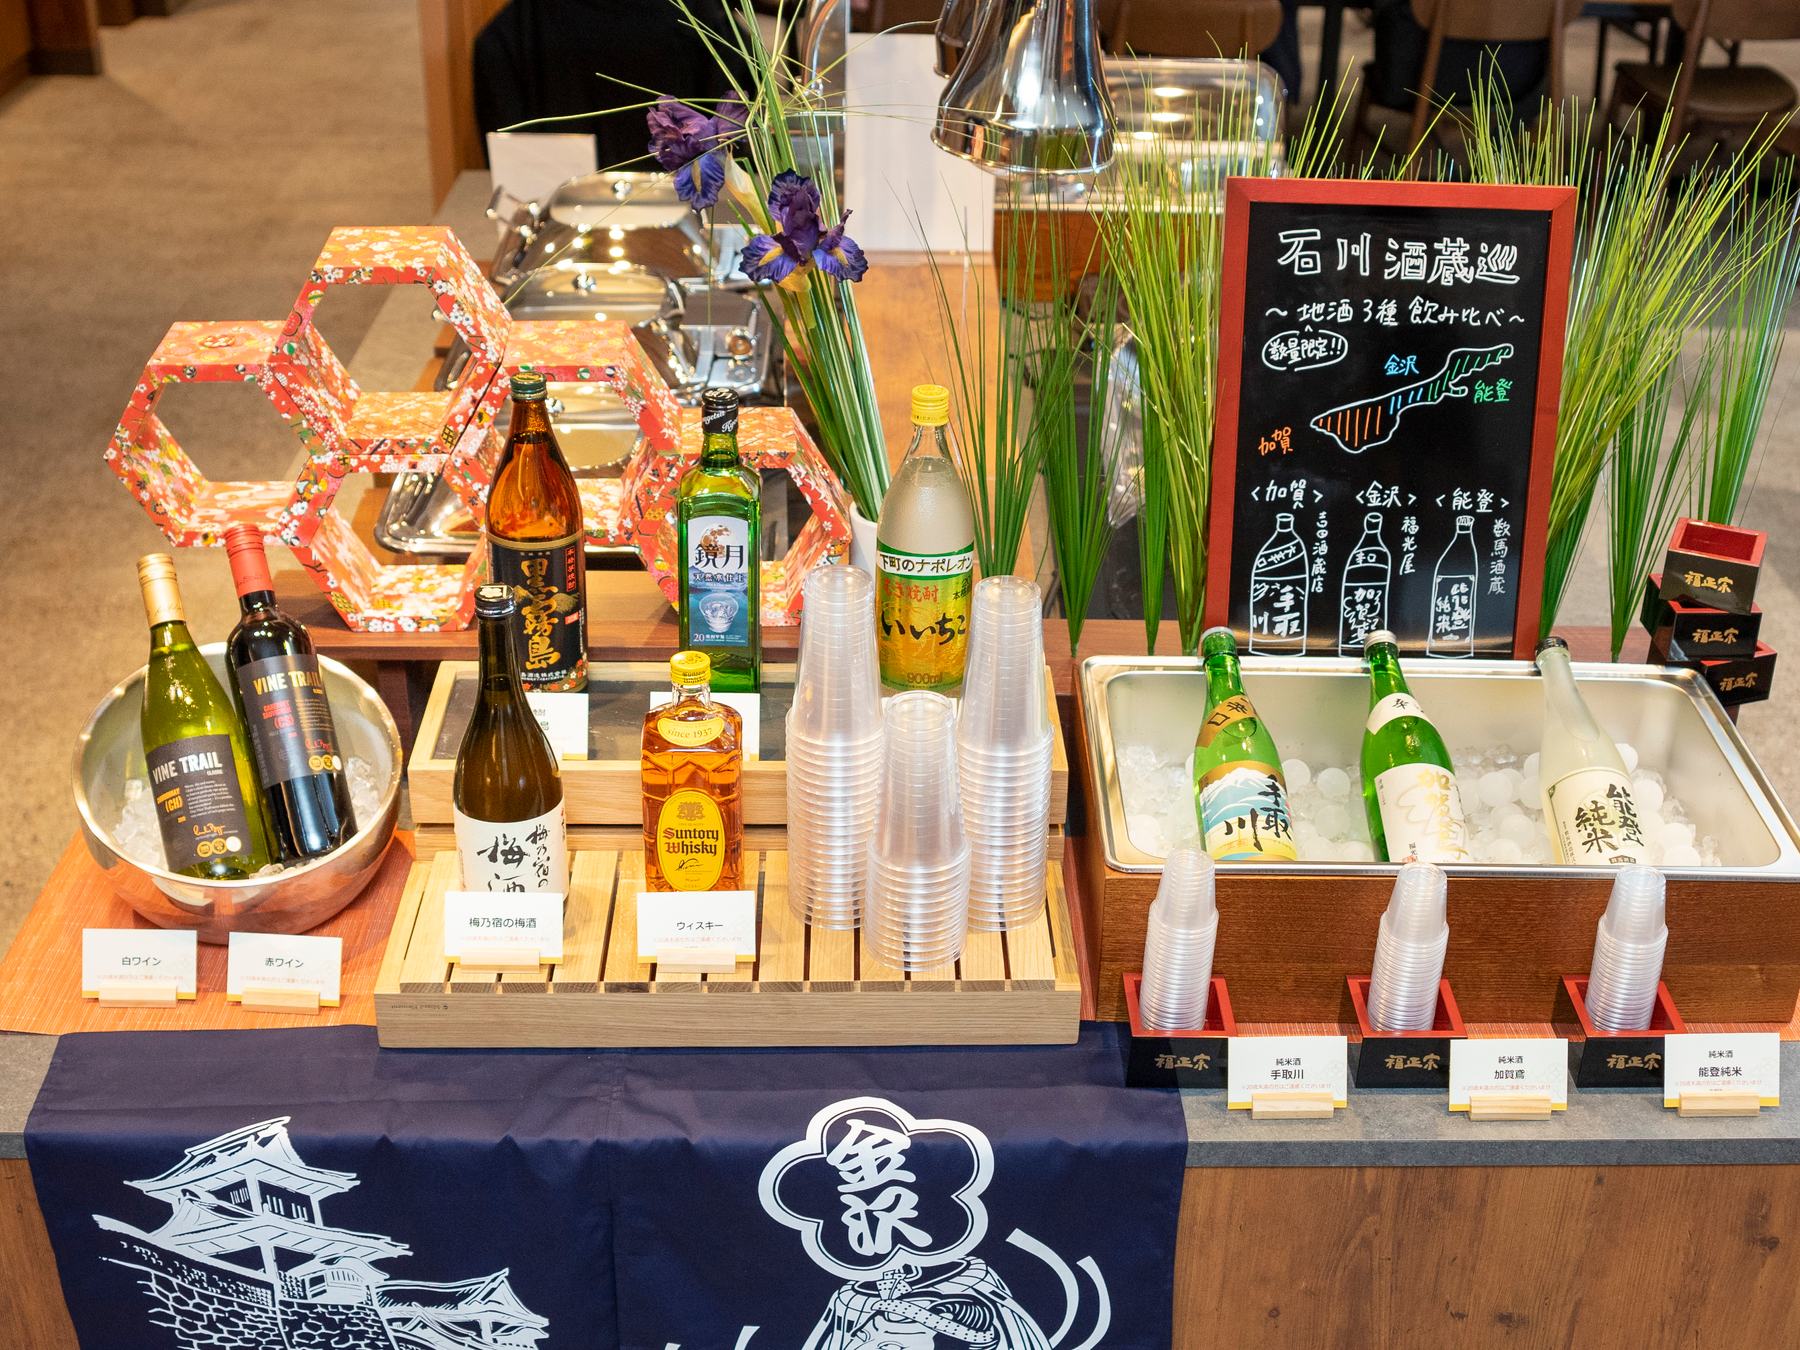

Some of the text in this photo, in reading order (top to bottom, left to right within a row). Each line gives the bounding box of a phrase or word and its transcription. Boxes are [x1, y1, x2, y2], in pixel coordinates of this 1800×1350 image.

[1384, 354, 1420, 376] 金沢
[1473, 380, 1513, 403] 能登
[1258, 426, 1294, 456] 加賀
[1399, 515, 1420, 576] 福光屋
[694, 543, 745, 570] 鏡月
[1683, 570, 1734, 593] 福正宗
[881, 612, 967, 646] いいちこ
[1692, 627, 1740, 645] 福正宗
[253, 672, 288, 696] VINE
[1719, 671, 1758, 692] 福正宗
[152, 751, 223, 785] VINE TRAIL
[663, 827, 719, 843] Suntory
[664, 841, 718, 857] Whisky
[469, 916, 537, 929] 梅乃宿の梅酒
[676, 920, 724, 931] ウィスキー
[121, 956, 162, 967] 白ワイン
[264, 957, 305, 969] 赤ワイン
[1154, 1053, 1212, 1071] 福正宗
[1275, 1057, 1302, 1067] 純米酒
[1384, 1053, 1441, 1071] 福正宗
[1498, 1055, 1524, 1064] 純米酒
[1606, 1052, 1662, 1071] 福正宗
[1708, 1050, 1734, 1059] 純米酒
[1270, 1069, 1305, 1080] 手取川
[1493, 1069, 1526, 1080] 加賀鳶
[1698, 1066, 1743, 1078] 能登純米
[826, 1118, 933, 1256] 金沢
